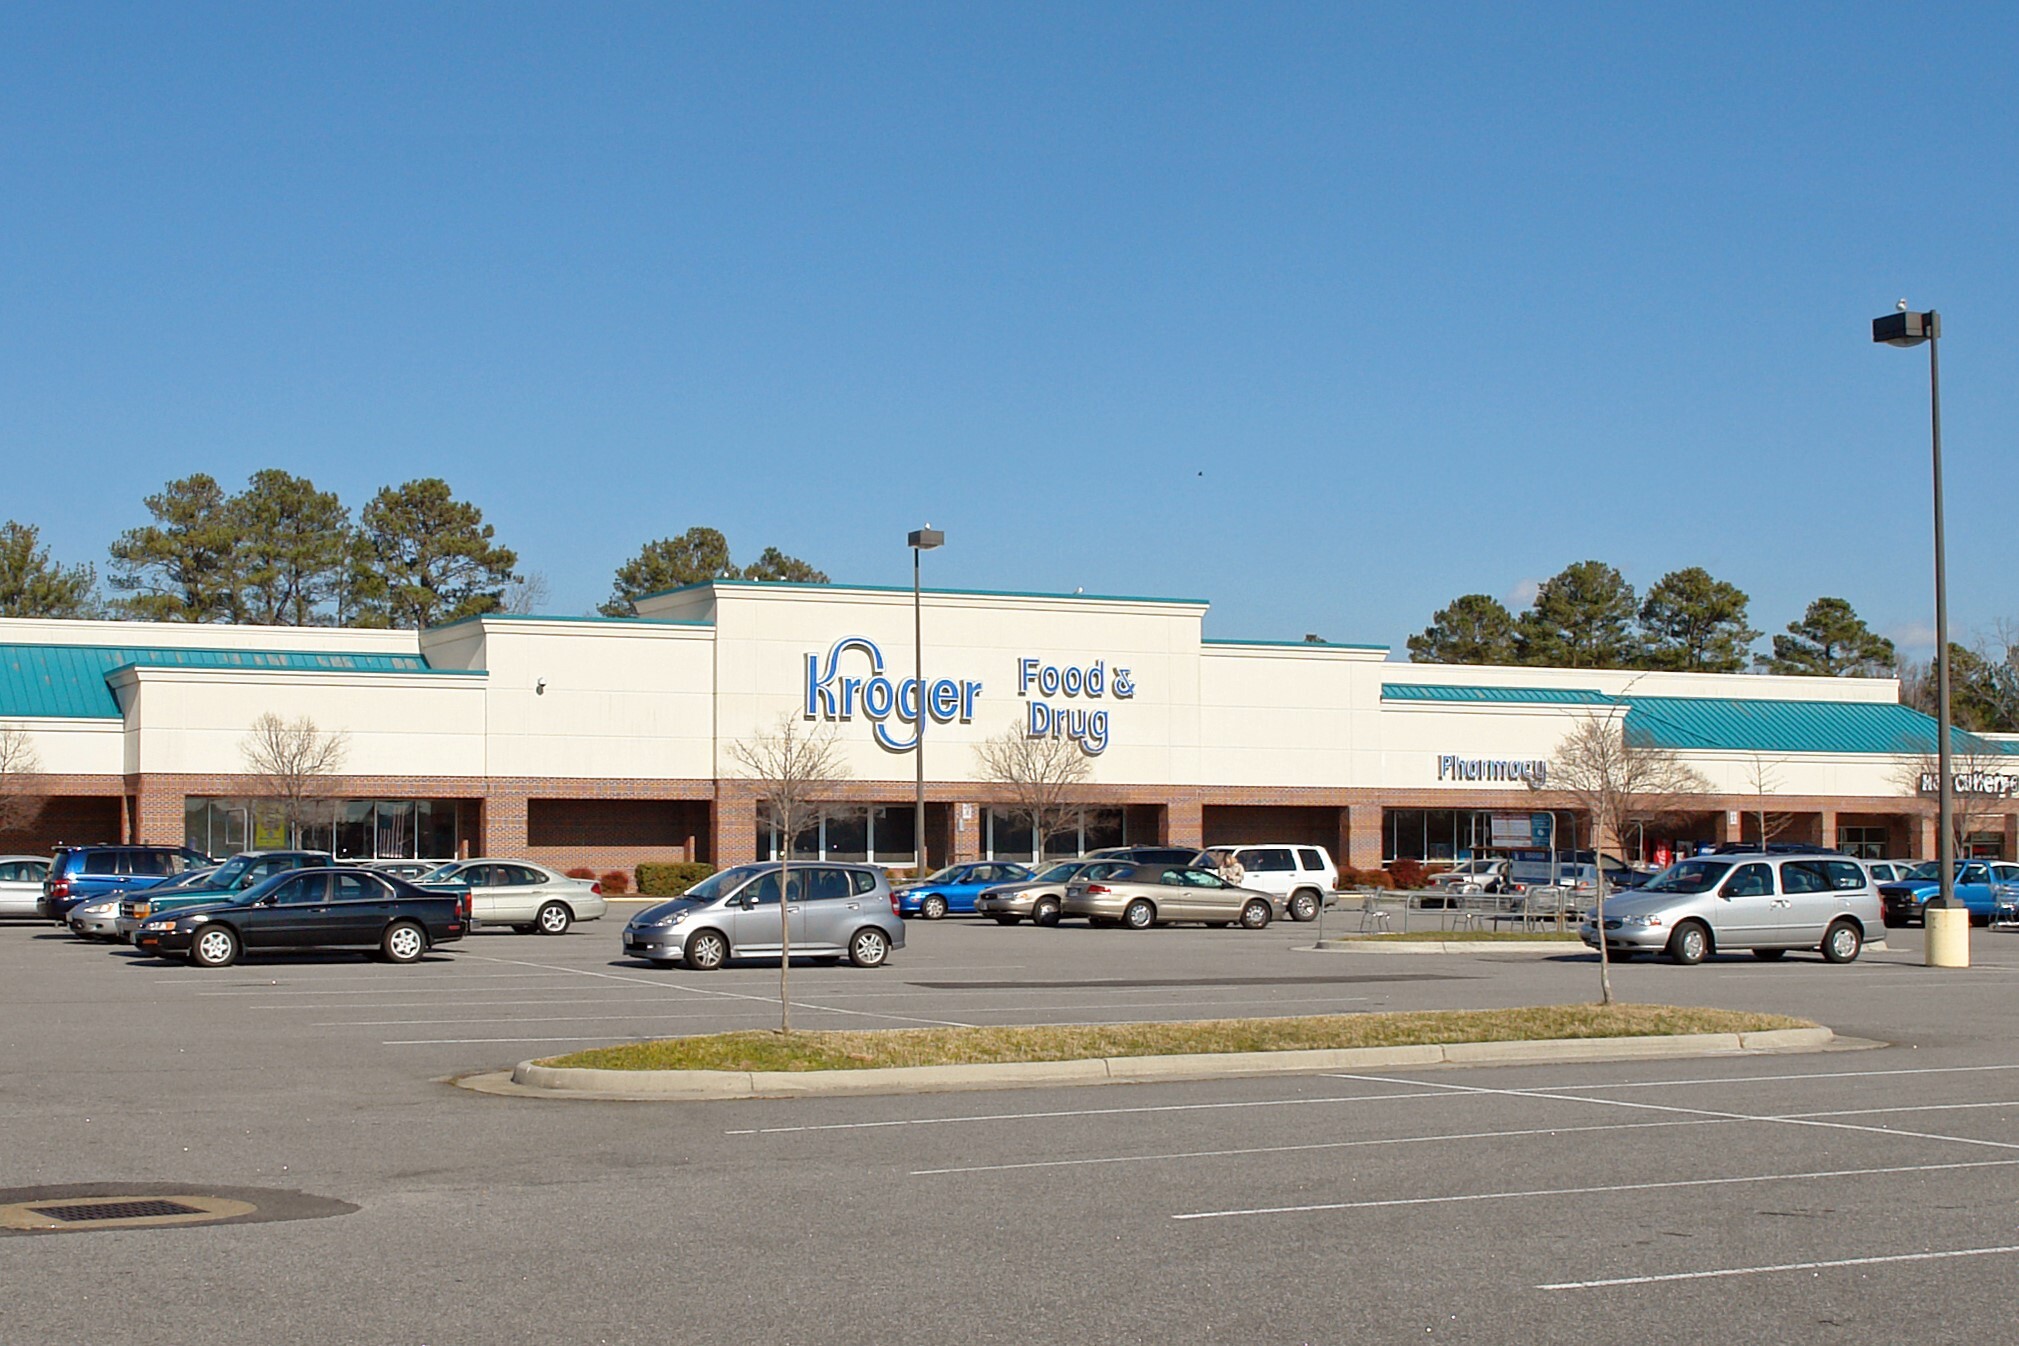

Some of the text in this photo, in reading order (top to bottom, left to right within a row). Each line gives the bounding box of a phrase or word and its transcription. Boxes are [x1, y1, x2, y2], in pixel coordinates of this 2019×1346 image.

[804, 634, 982, 751] Kroger
[1019, 657, 1135, 699] Food &
[1026, 700, 1110, 756] Drug
[1439, 754, 1548, 789] Pharmacy
